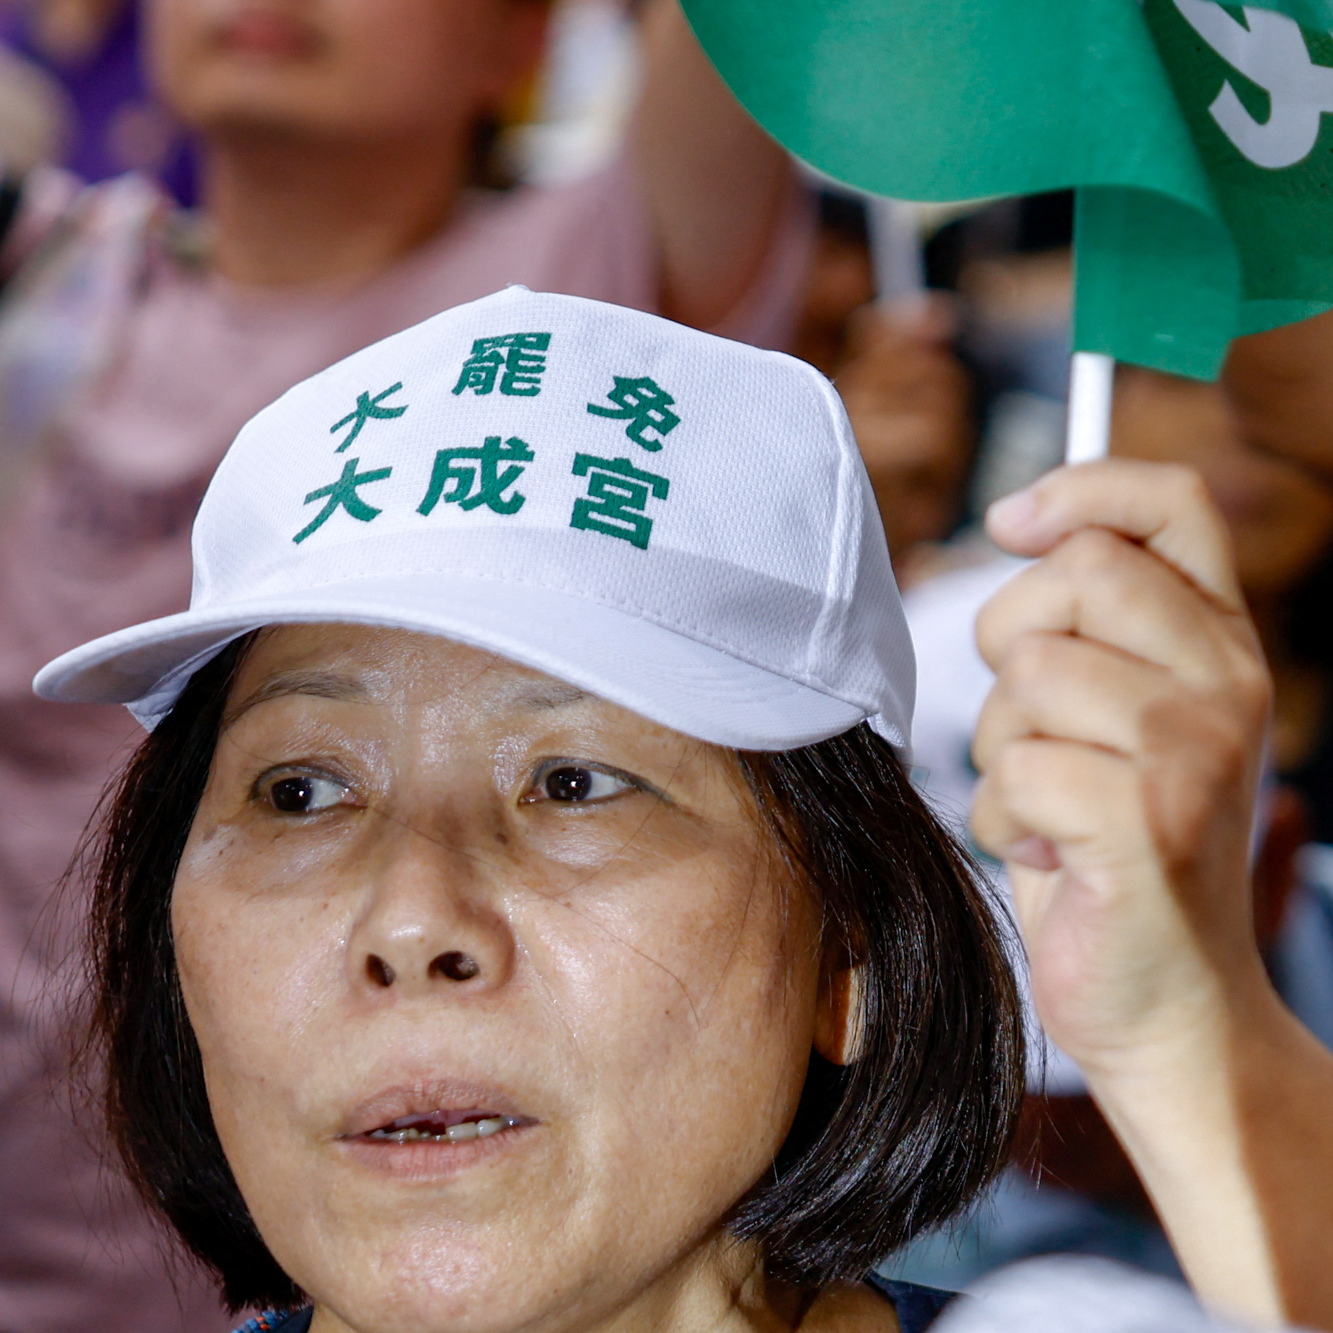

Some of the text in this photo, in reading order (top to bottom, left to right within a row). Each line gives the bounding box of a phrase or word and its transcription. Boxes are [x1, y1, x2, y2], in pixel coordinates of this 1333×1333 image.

[329, 331, 682, 454] 大罷免
[291, 435, 673, 551] 大成宮
